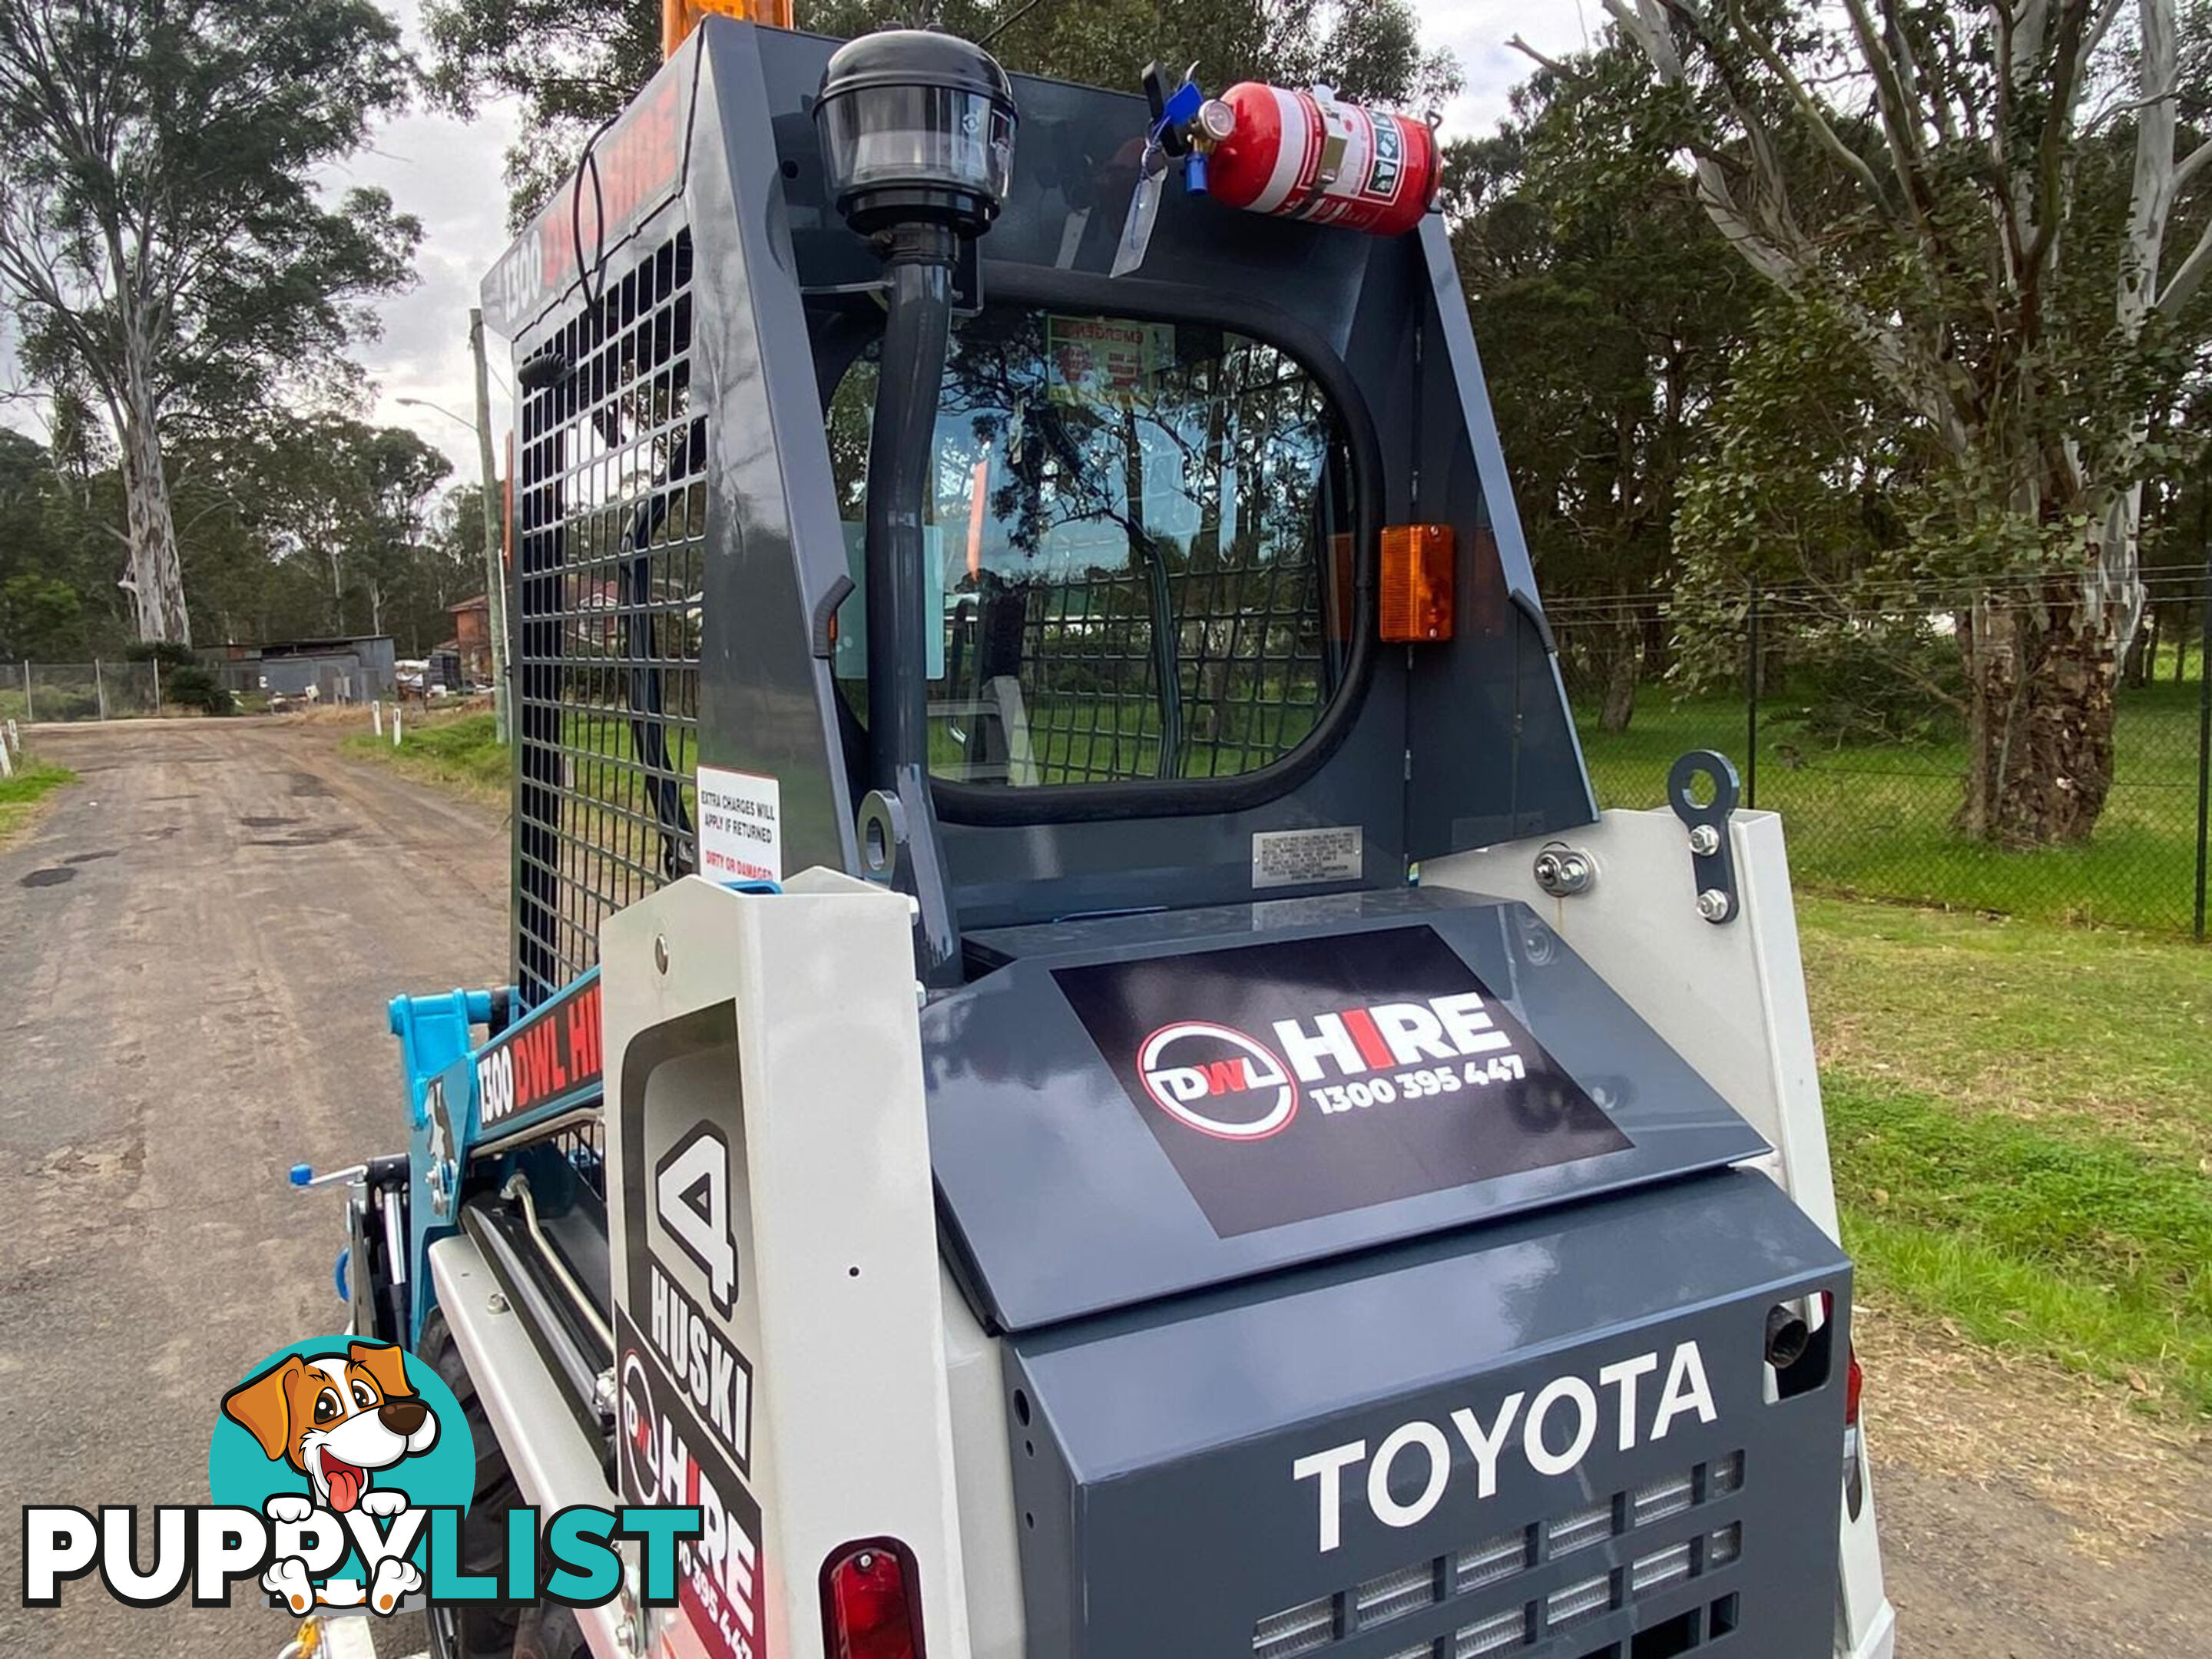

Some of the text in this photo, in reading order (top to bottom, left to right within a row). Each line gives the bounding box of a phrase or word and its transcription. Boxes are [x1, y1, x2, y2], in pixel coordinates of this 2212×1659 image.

[701, 790, 775, 821] EXTRA CHARGES WILL
[704, 813, 773, 843] APPLY IF RETURNED
[706, 850, 773, 880] DIRTY OR DAMAGED
[477, 1045, 514, 1123] 1300
[513, 1015, 566, 1107] DWL
[1273, 992, 1512, 1083] HIRE
[1145, 1056, 1290, 1101] DWL
[1309, 1054, 1526, 1114] 1300 395 447
[657, 1134, 734, 1306] 4
[651, 1263, 748, 1461] HUSKI
[1293, 1340, 1717, 1553] TOYOTA
[662, 1413, 754, 1637] HIRE
[690, 1556, 719, 1624] 395
